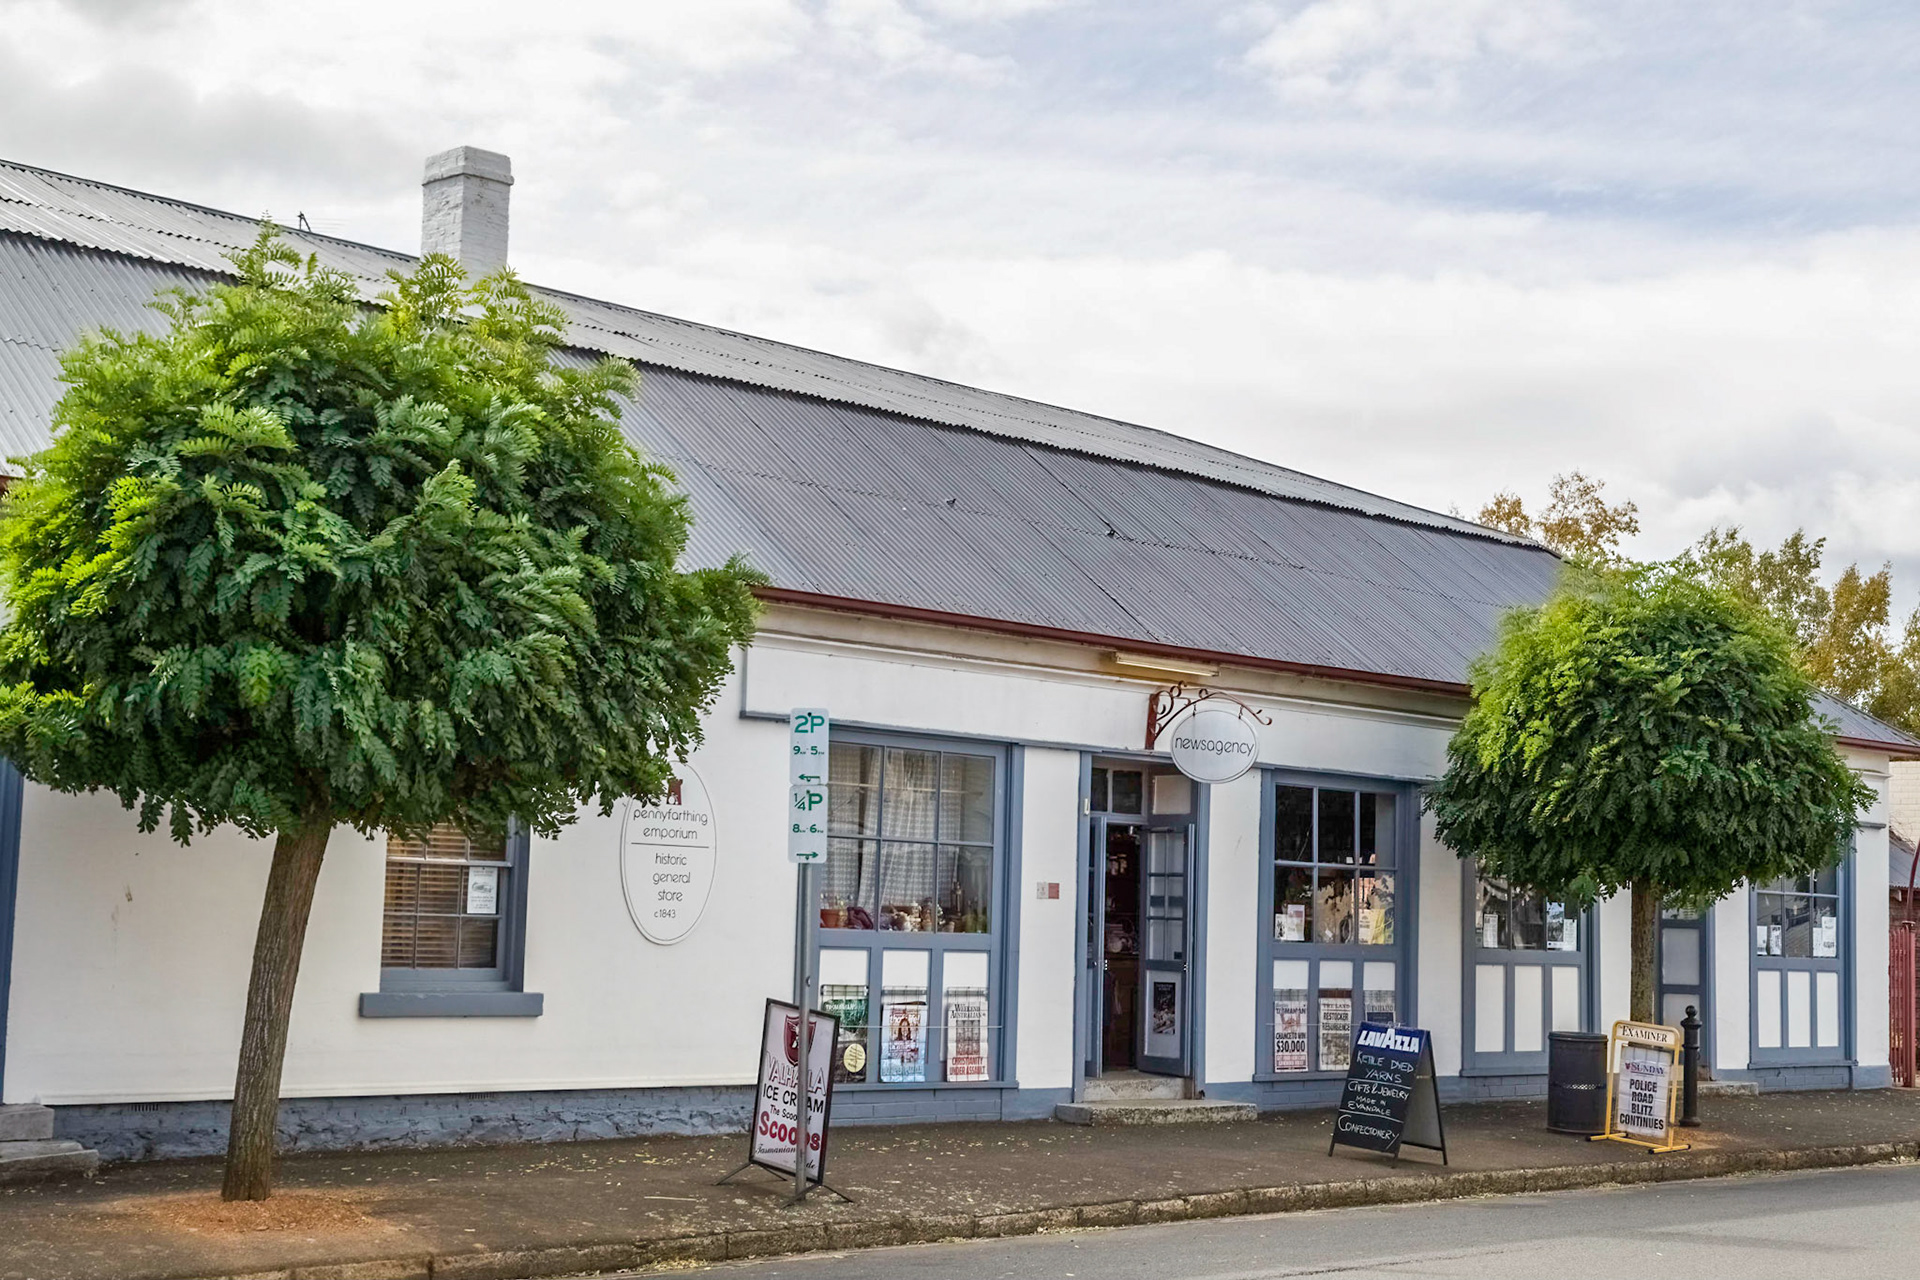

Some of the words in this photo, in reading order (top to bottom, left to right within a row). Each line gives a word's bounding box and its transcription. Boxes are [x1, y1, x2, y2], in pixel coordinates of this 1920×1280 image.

[794, 715, 825, 733] 2P
[1175, 737, 1254, 756] newsagency
[633, 808, 708, 826] pennyfarthing
[643, 827, 698, 840] emporium
[655, 853, 687, 866] historic
[652, 872, 691, 885] general
[657, 890, 683, 901] store
[1357, 1028, 1419, 1053] LAVAZZA
[1622, 1025, 1668, 1042] EXAMINER
[1276, 1041, 1305, 1053] $30,000
[1390, 1059, 1414, 1073] DYED
[1631, 1062, 1664, 1075] SUNDAY
[1365, 1068, 1402, 1083] YARNS
[1348, 1080, 1370, 1094] GIFTS
[1629, 1078, 1657, 1093] POLICE
[763, 1083, 779, 1101] ICE
[783, 1090, 824, 1114] CRAM
[1356, 1095, 1376, 1105] MADE
[1631, 1092, 1654, 1104] ROAD
[770, 1104, 780, 1116] The
[782, 1108, 798, 1121] Scoo
[1347, 1100, 1391, 1116] EVANDALE
[1631, 1103, 1653, 1116] BLITZ
[1620, 1113, 1664, 1130] CONTINUES
